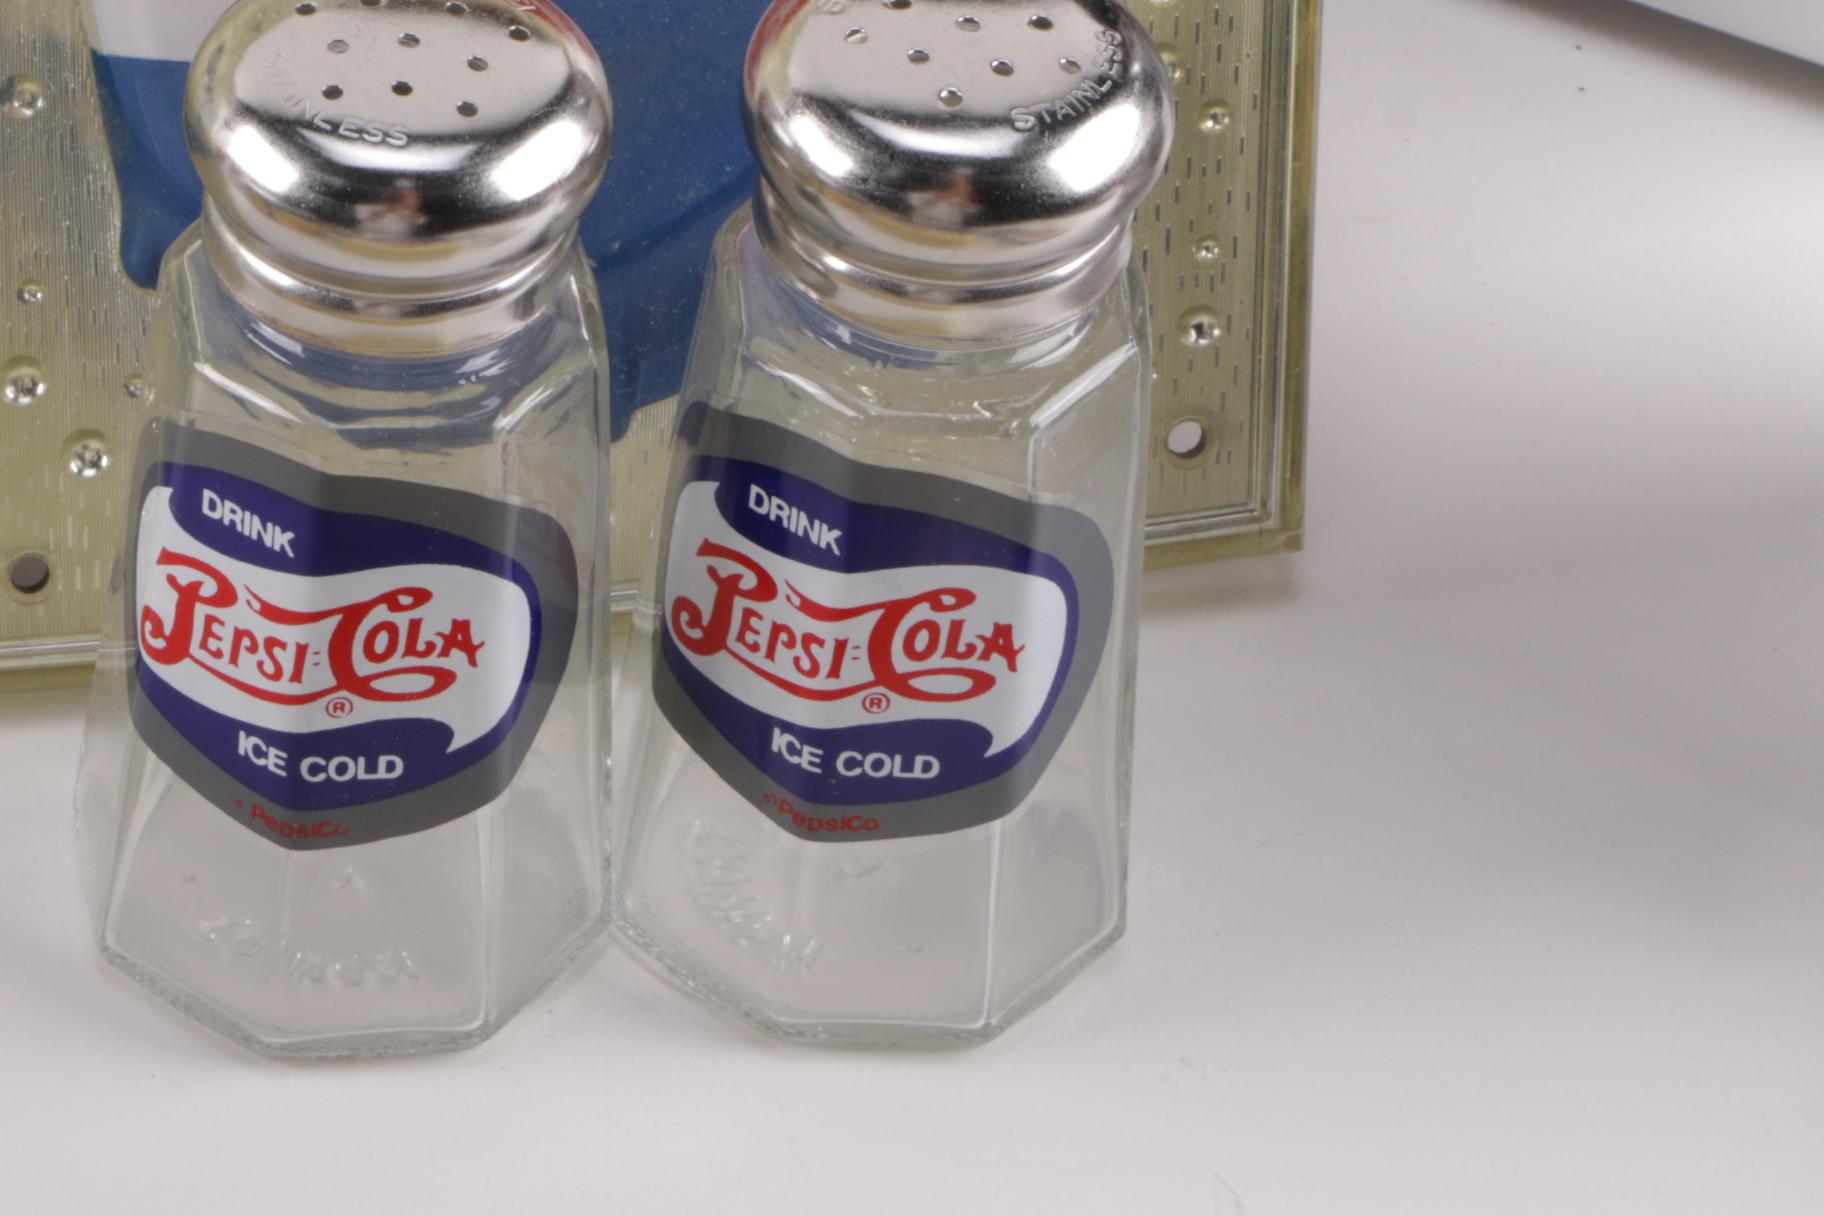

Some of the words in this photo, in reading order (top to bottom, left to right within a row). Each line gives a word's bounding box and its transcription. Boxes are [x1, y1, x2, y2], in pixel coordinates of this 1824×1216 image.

[202, 487, 296, 558] DRINK
[748, 483, 844, 556] DRINK
[237, 730, 288, 777] ICE
[300, 754, 404, 782] COLD
[771, 726, 823, 774] ICE
[835, 751, 941, 779] COLD
